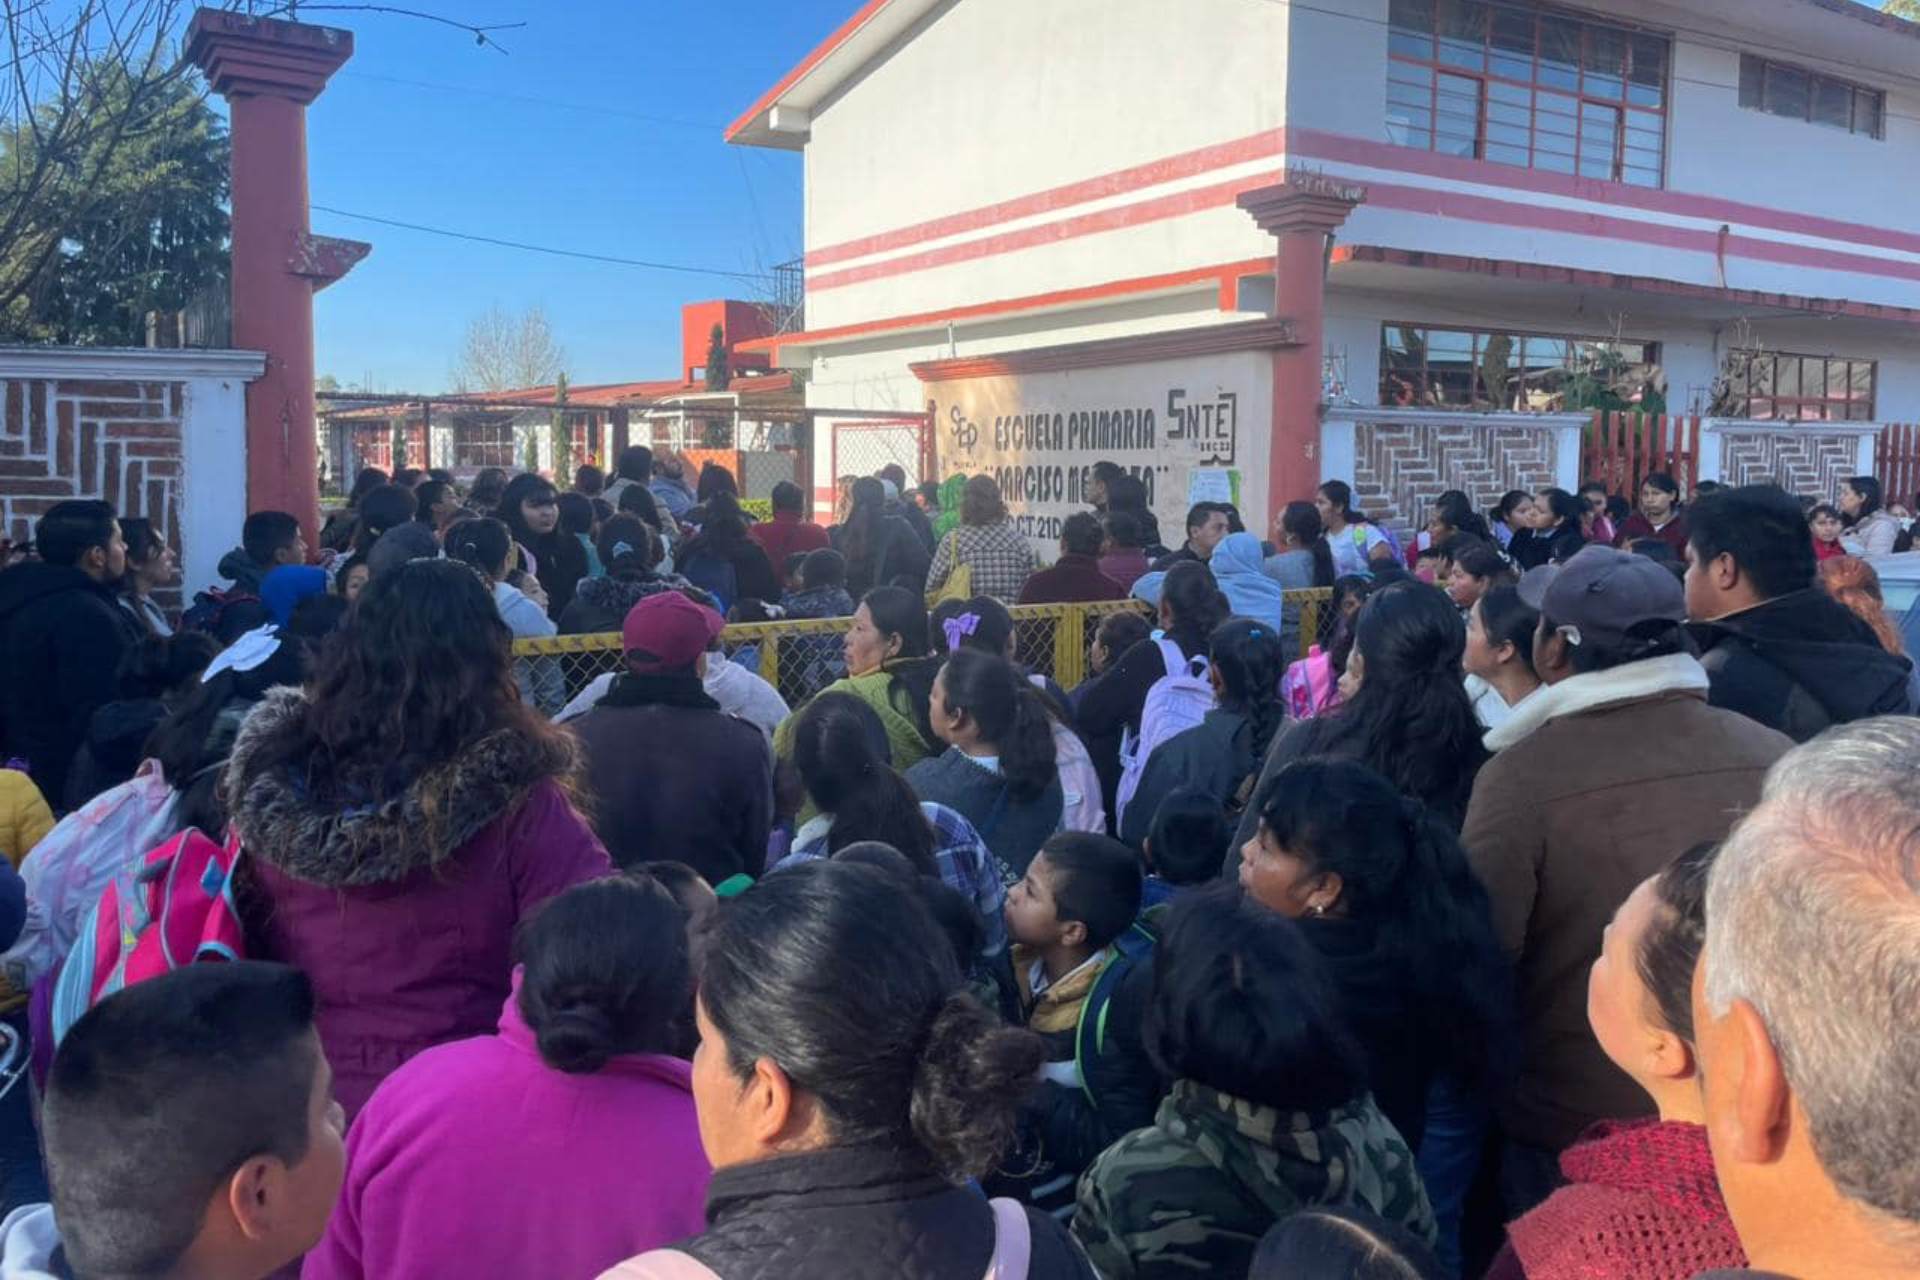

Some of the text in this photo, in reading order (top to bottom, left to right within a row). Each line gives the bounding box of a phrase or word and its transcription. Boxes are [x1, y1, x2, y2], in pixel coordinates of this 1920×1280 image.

[950, 405, 978, 454] SEP
[995, 408, 1155, 451] ESCUELA PRIMARIA
[1167, 389, 1230, 439] SNTE
